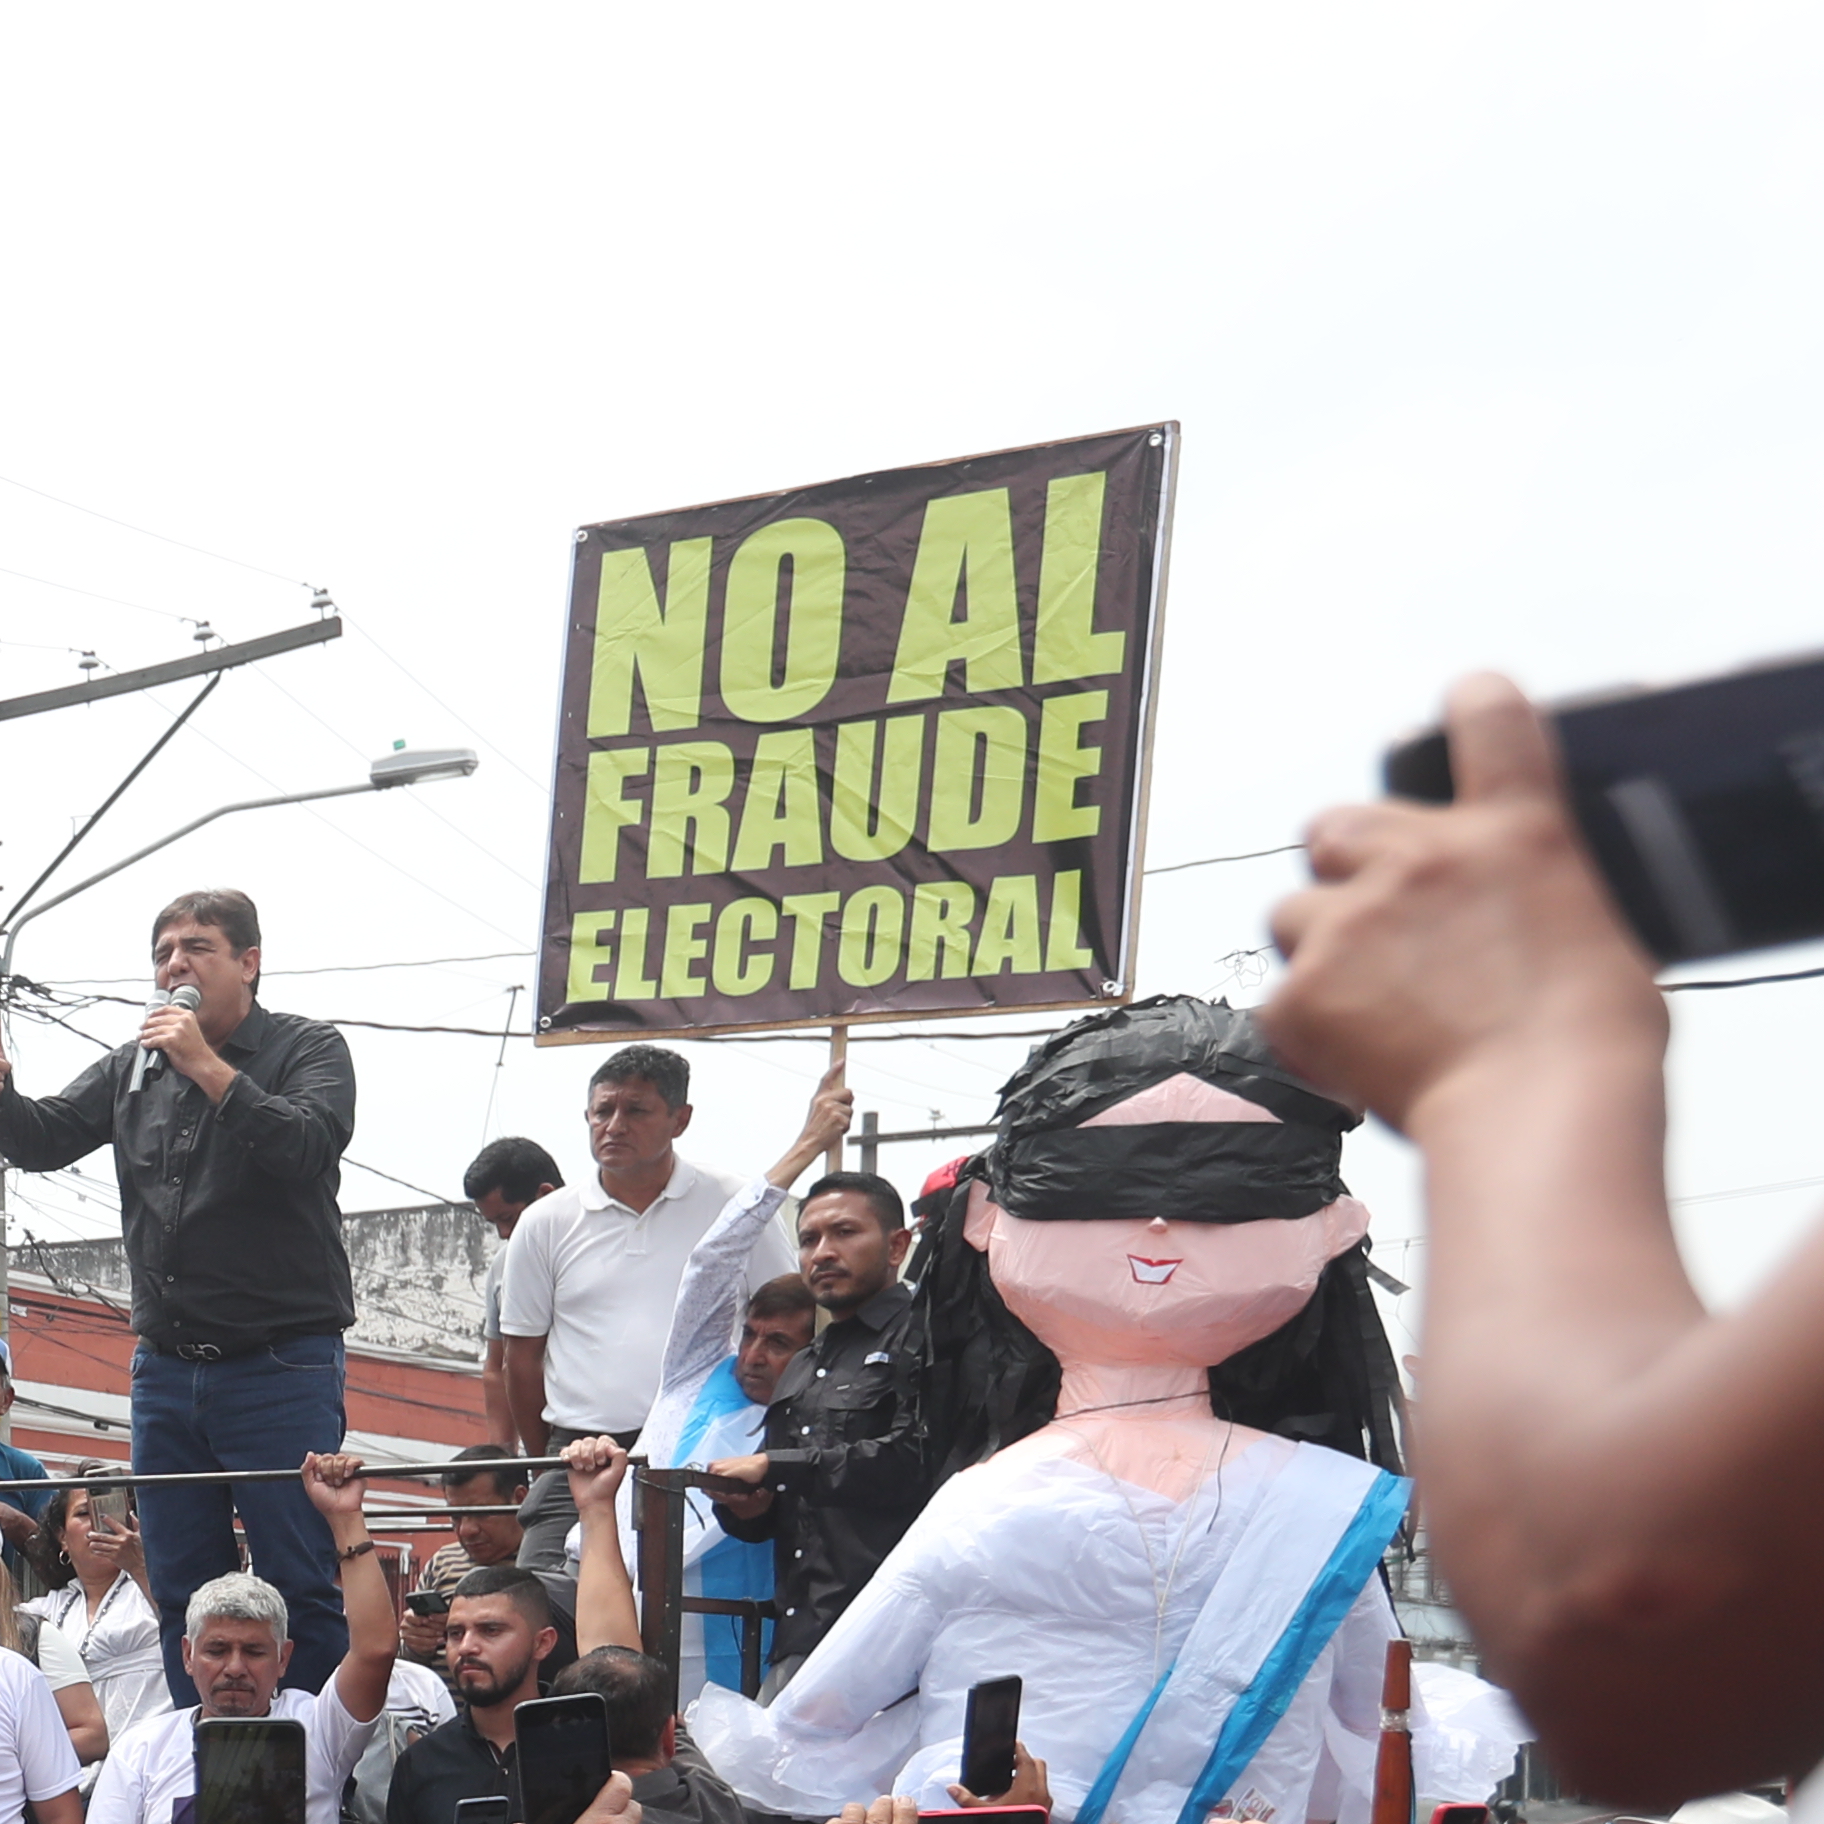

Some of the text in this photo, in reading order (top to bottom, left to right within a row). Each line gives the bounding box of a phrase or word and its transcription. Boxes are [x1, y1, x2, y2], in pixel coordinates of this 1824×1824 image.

[586, 471, 1125, 738] NO AL
[578, 691, 1108, 885] FRAUDE
[566, 871, 1093, 1004] ELECTORAL
